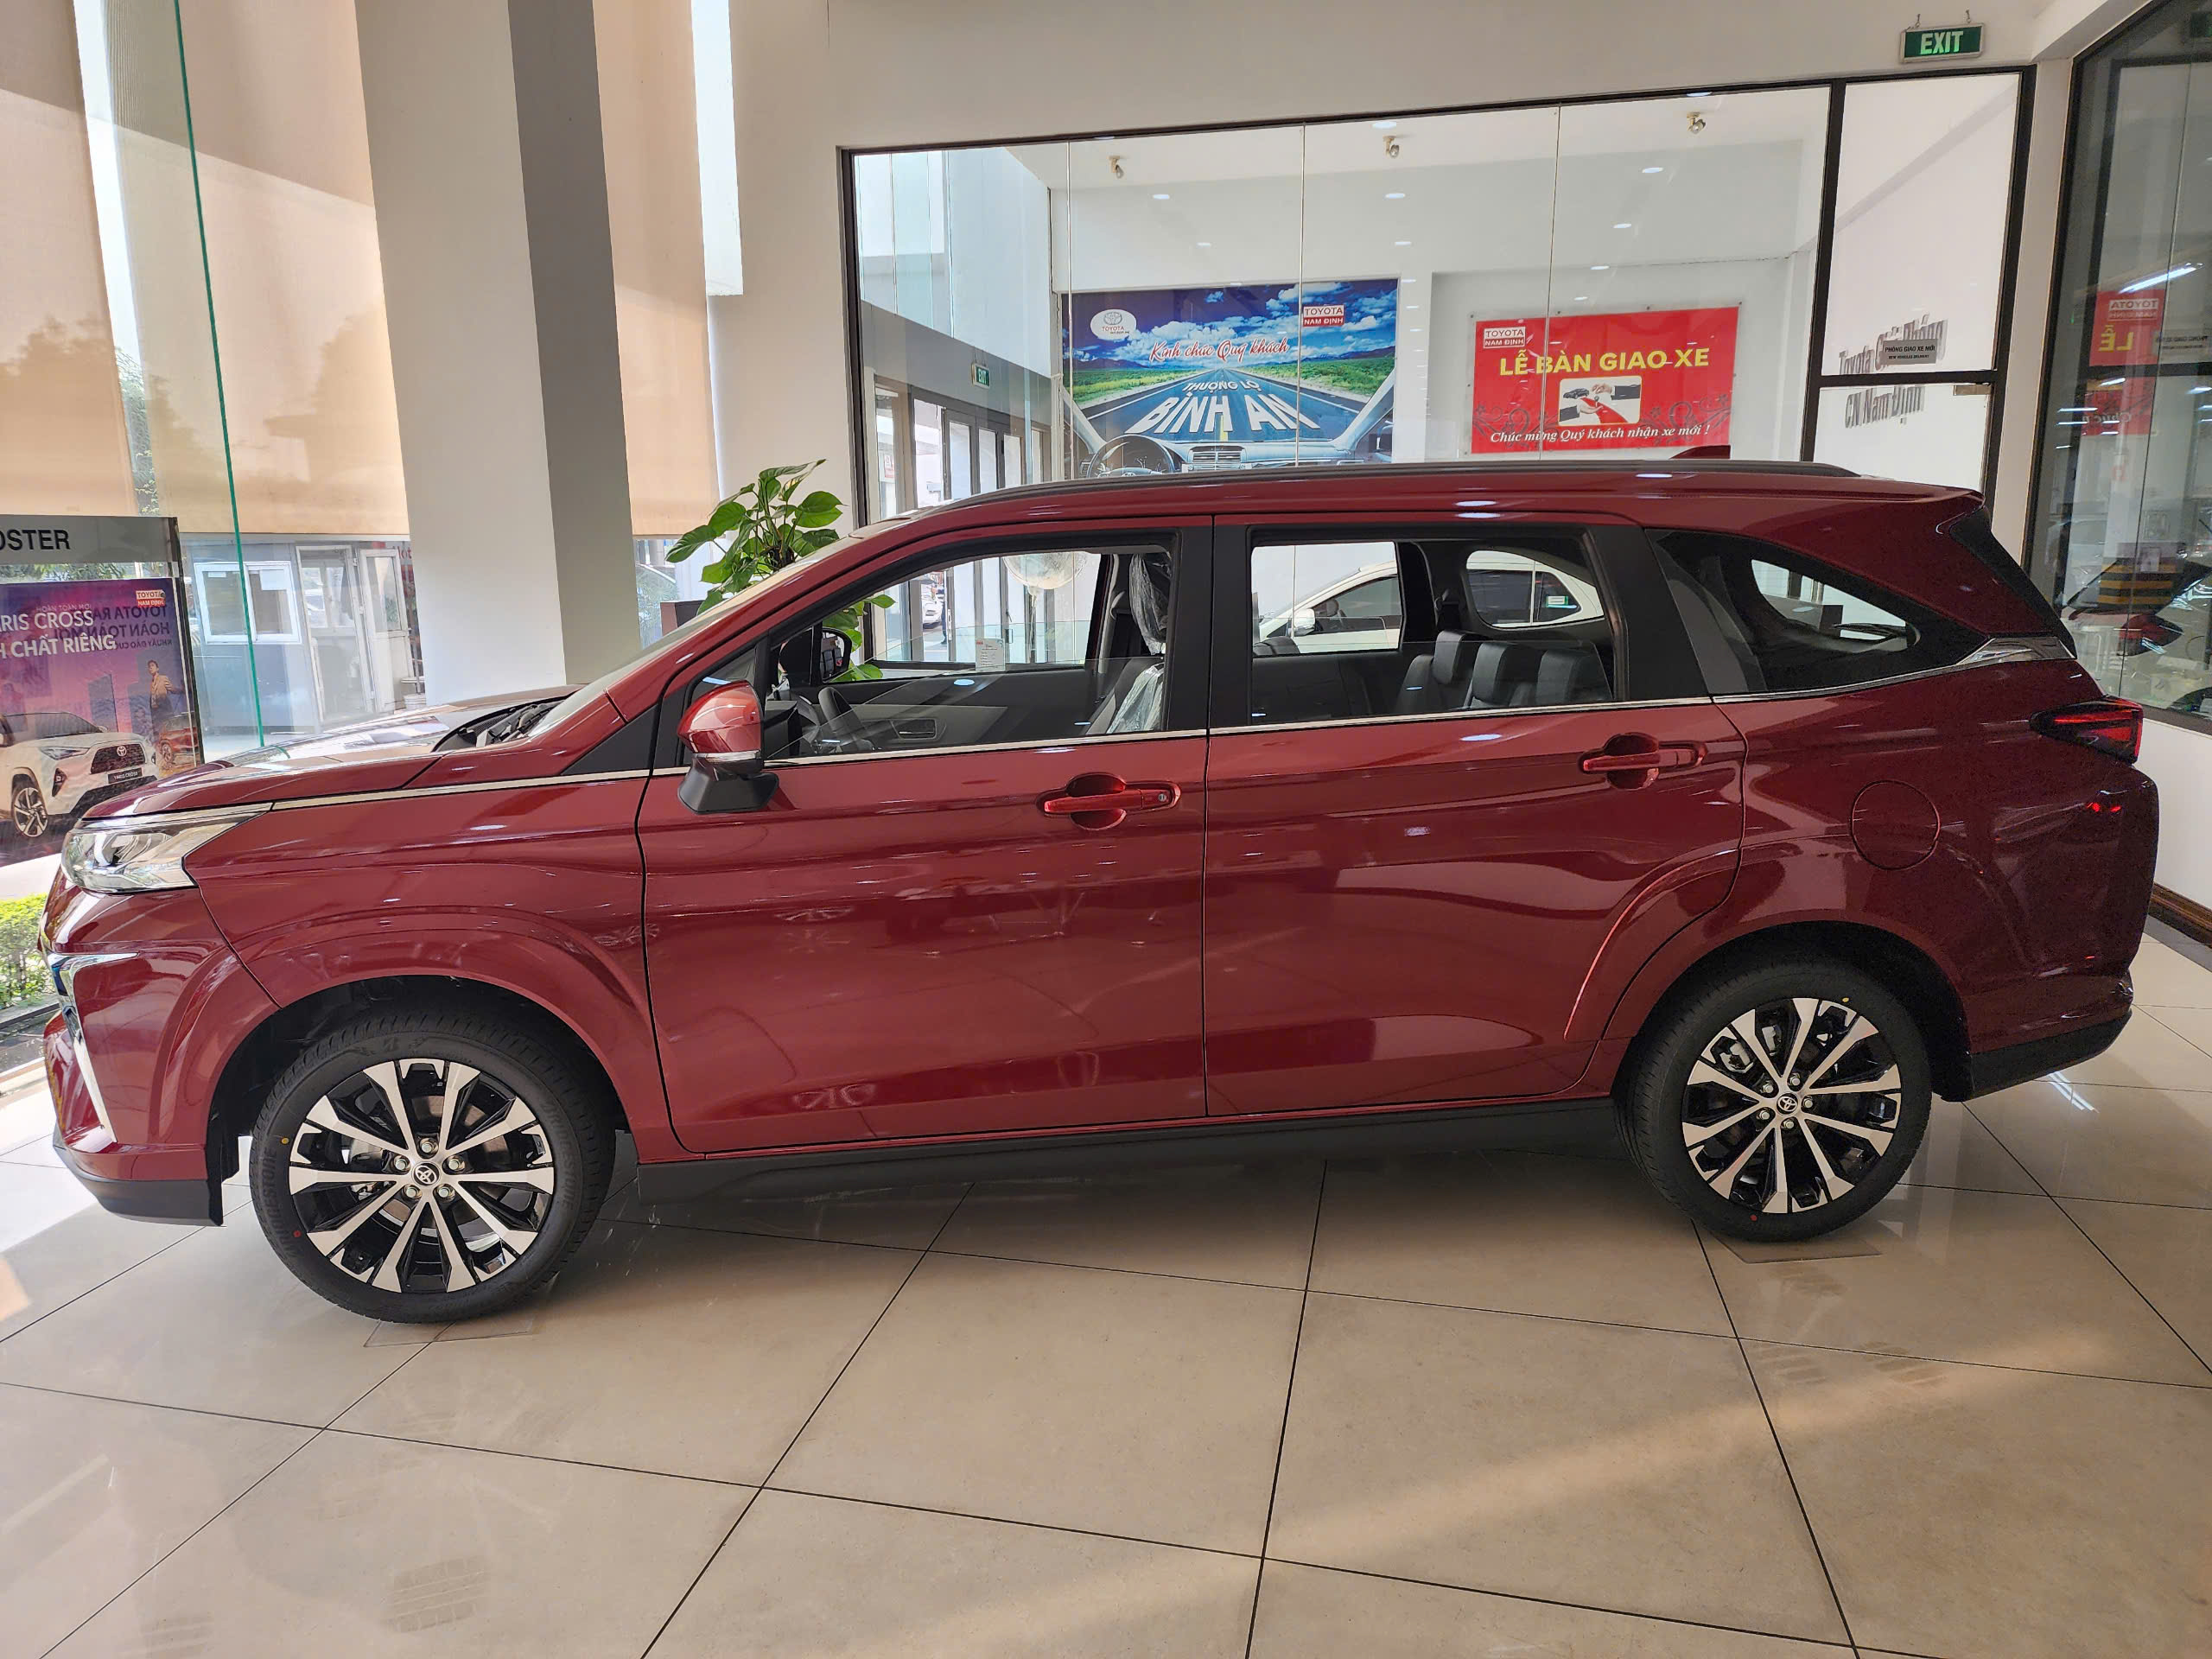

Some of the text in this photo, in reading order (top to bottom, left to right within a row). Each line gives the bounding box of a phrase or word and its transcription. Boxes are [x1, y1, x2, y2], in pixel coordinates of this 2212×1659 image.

[1920, 30, 1964, 54] EXIT
[1305, 307, 1344, 315] TOYOTA
[1217, 339, 1249, 363] Quý
[1249, 336, 1289, 355] khách
[1500, 347, 1710, 376] LỄ BÀN GIAO XE
[978, 368, 987, 385] EXIT
[1244, 393, 1321, 431] AN
[1491, 431, 1522, 443] Chúc
[1560, 429, 1586, 442] Quý
[1586, 427, 1624, 439] khách
[1627, 426, 1659, 439] nhận
[1661, 427, 1675, 436] xe
[1678, 423, 1702, 435] mới
[0, 613, 29, 632] RIS
[35, 610, 94, 629] CROSS
[10, 633, 59, 658] CHẤT
[63, 632, 117, 654] RIÊNG
